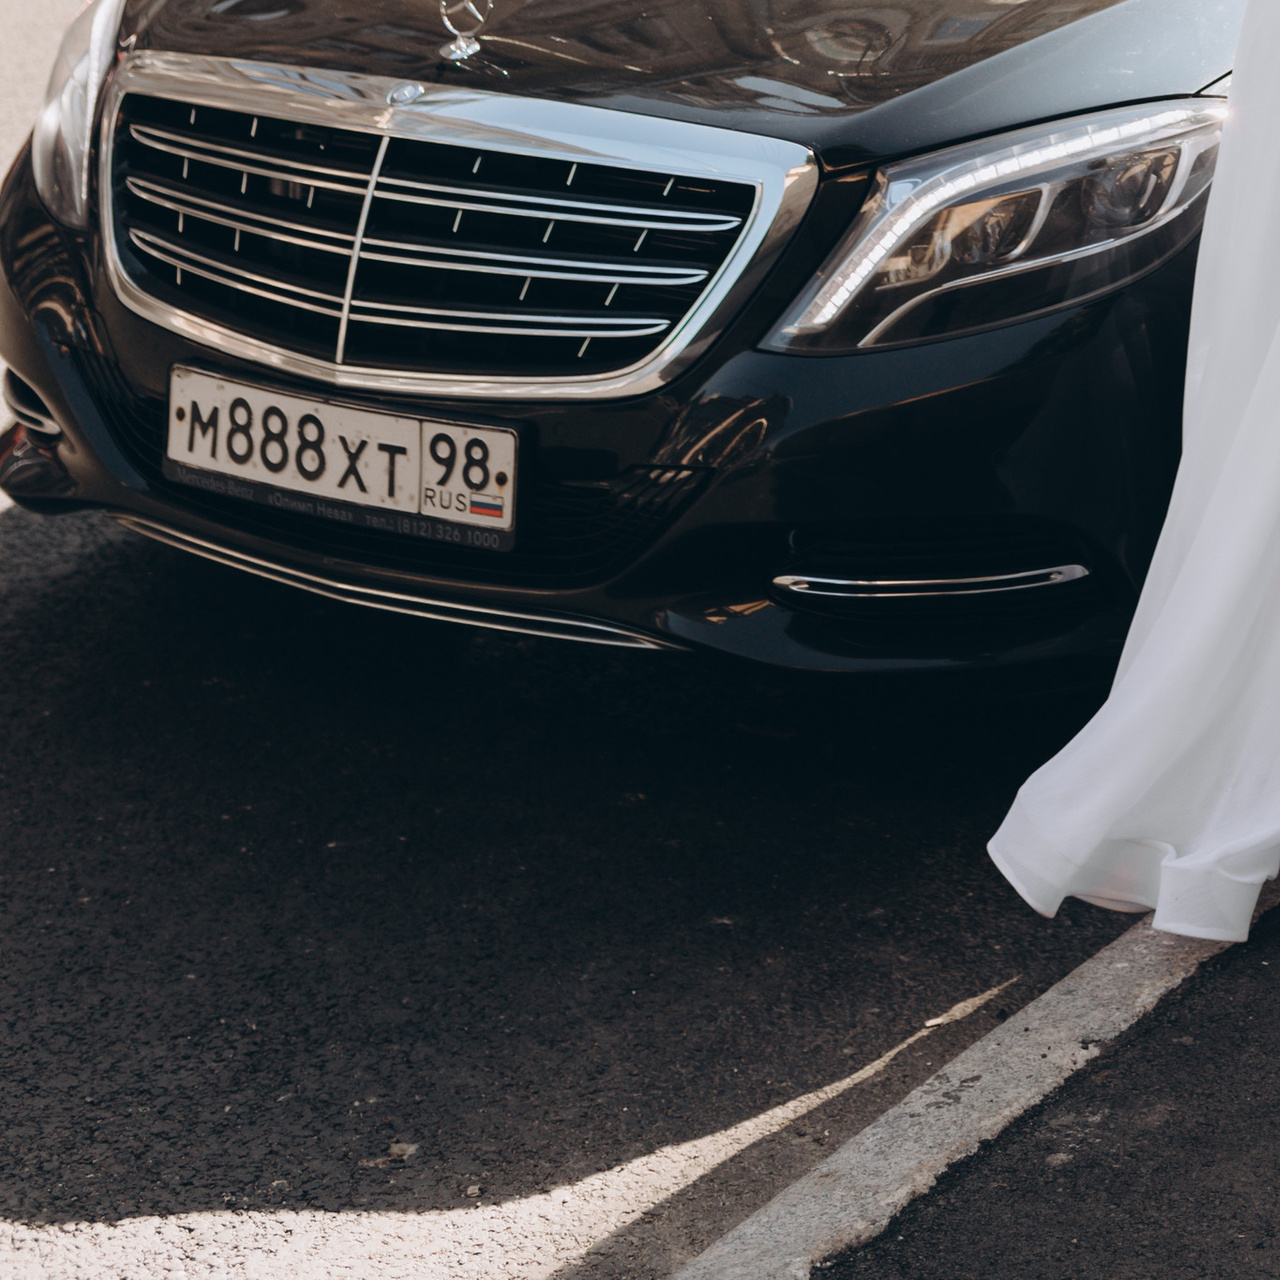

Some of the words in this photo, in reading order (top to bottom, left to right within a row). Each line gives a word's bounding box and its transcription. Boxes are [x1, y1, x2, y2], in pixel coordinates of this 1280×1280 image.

[188, 397, 408, 498] М888ХТ
[429, 433, 490, 491] 98
[176, 468, 255, 501] Mercedes-Benz
[398, 516, 432, 538] (812)
[436, 524, 462, 542] 326
[467, 530, 500, 549] 1000
[424, 488, 467, 512] RUS
